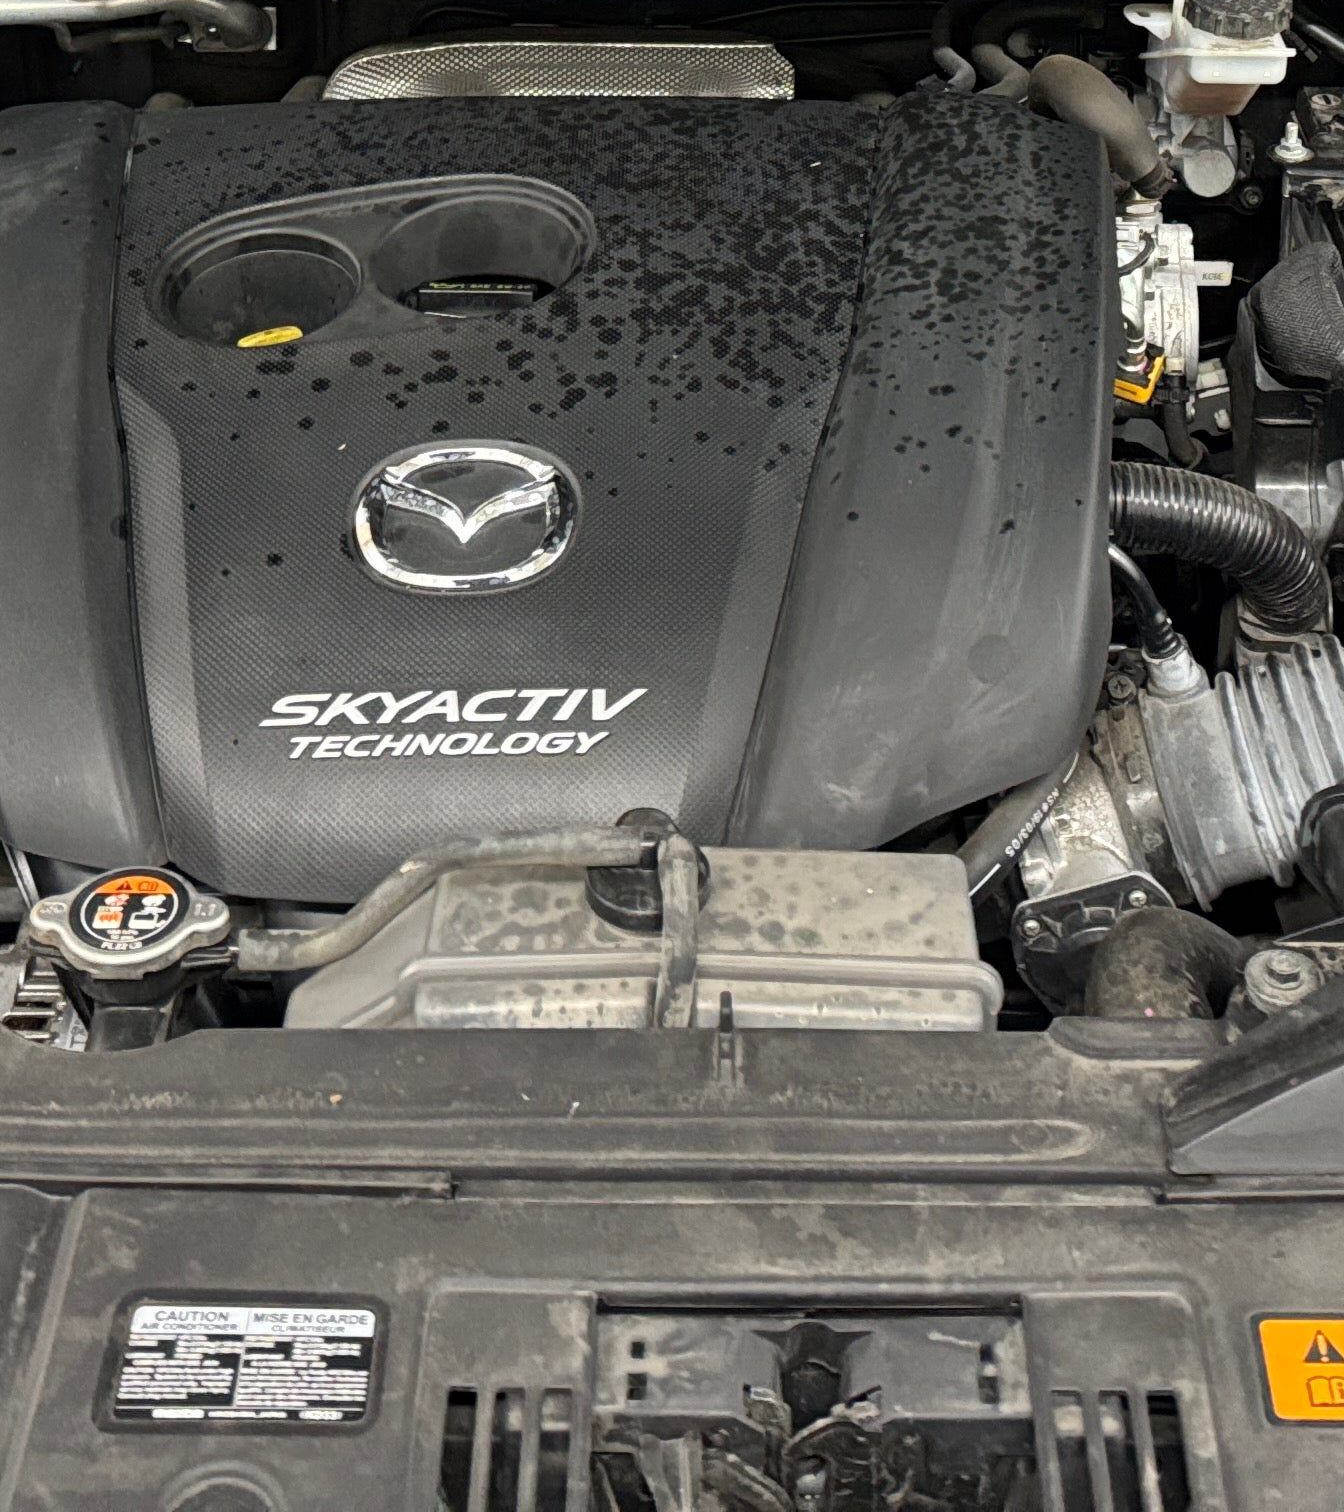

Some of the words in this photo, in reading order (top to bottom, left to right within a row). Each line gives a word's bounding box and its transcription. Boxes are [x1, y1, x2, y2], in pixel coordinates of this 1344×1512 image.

[259, 688, 648, 727] SKYACTIV
[288, 731, 610, 759] TECHNOLOGY
[155, 1310, 230, 1322] CAUTION
[254, 1313, 288, 1323] MISE
[293, 1314, 313, 1324] EN
[316, 1314, 369, 1325] GARDE
[160, 1323, 238, 1332] CONDITIONER
